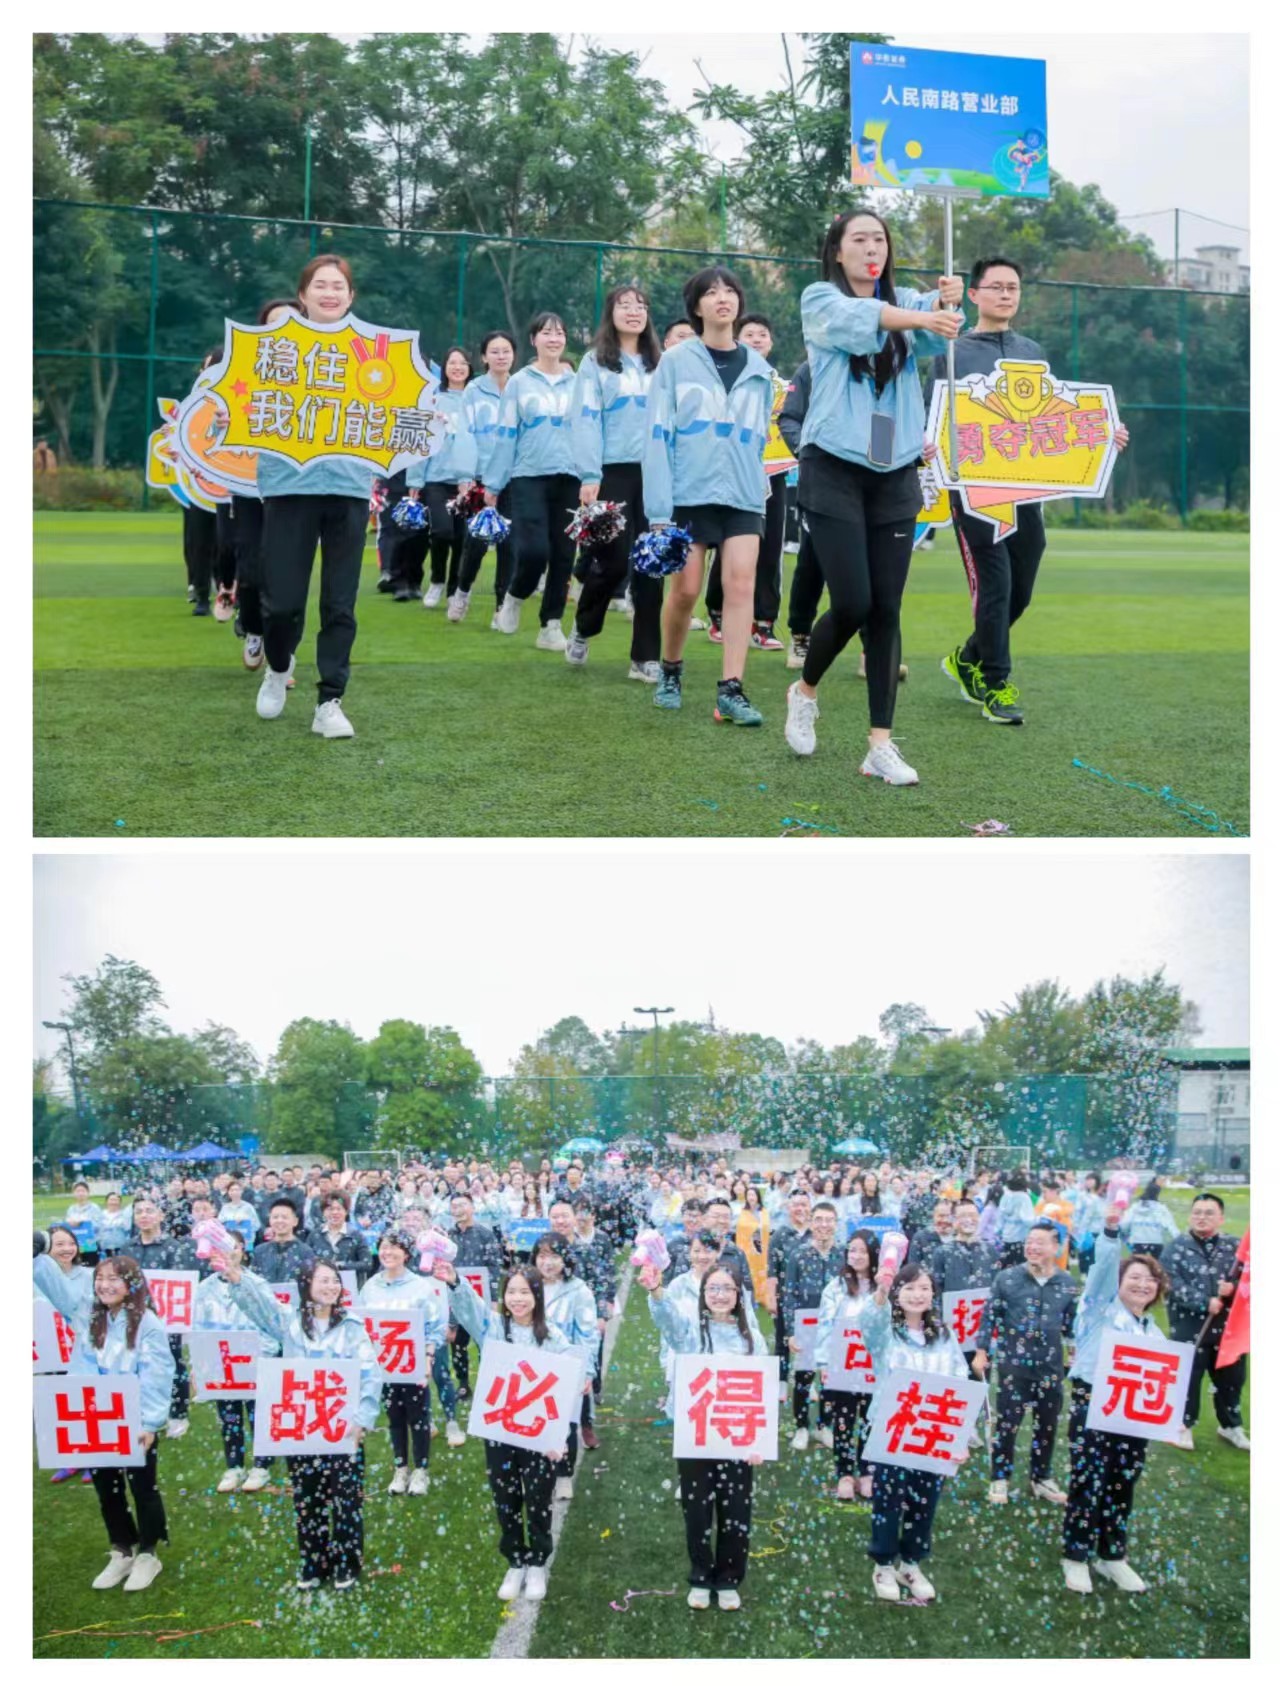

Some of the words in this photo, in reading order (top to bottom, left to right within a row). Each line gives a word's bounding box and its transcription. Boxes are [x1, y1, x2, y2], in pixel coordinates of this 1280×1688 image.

[881, 85, 1018, 116] 人民南路营业部
[254, 336, 348, 392] 稳住
[249, 390, 434, 456] 我们能赢
[957, 408, 1108, 464] 勇夺冠军
[205, 1340, 256, 1392] 上
[483, 1360, 560, 1438] 必
[1101, 1343, 1180, 1426] 冠
[55, 1386, 132, 1456] 出
[269, 1369, 348, 1443] 战
[687, 1367, 767, 1447] 得
[886, 1381, 968, 1461] 桂
